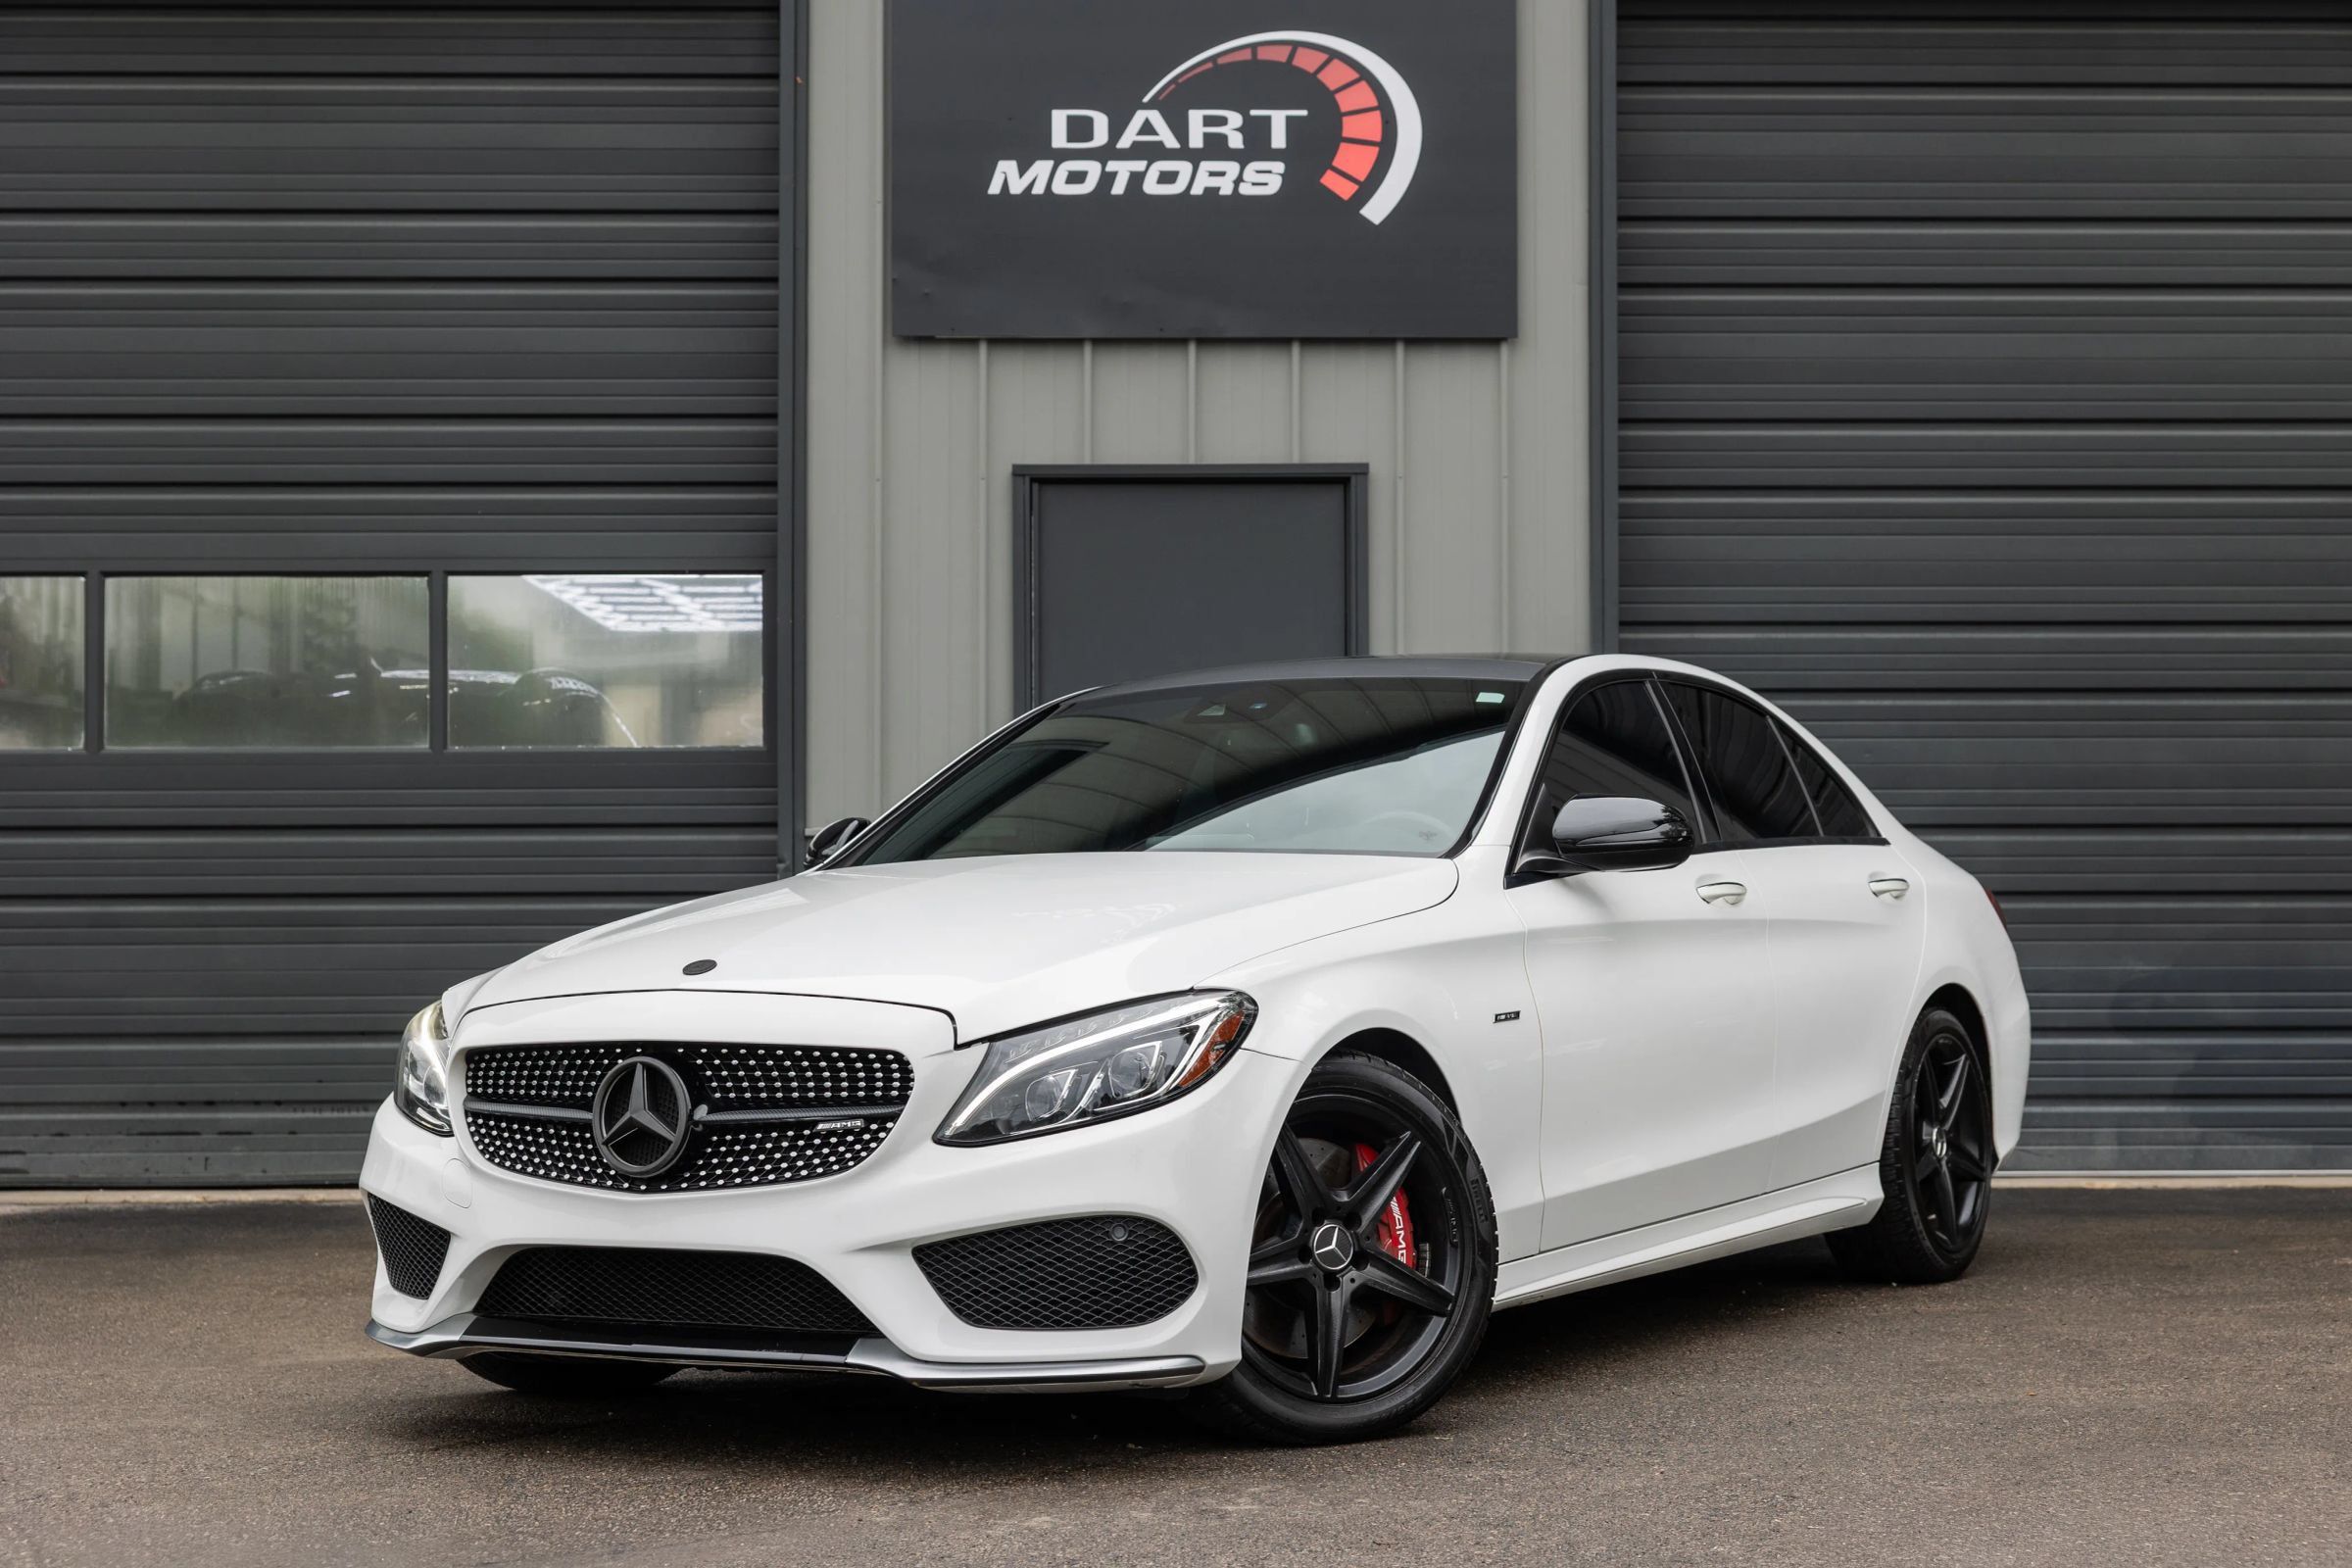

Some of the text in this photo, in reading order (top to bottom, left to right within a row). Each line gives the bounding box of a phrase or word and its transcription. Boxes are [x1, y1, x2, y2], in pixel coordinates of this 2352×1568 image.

[1051, 109, 1308, 149] DART
[987, 160, 1285, 195] MOTORS
[1396, 1214, 1407, 1264] AMG
